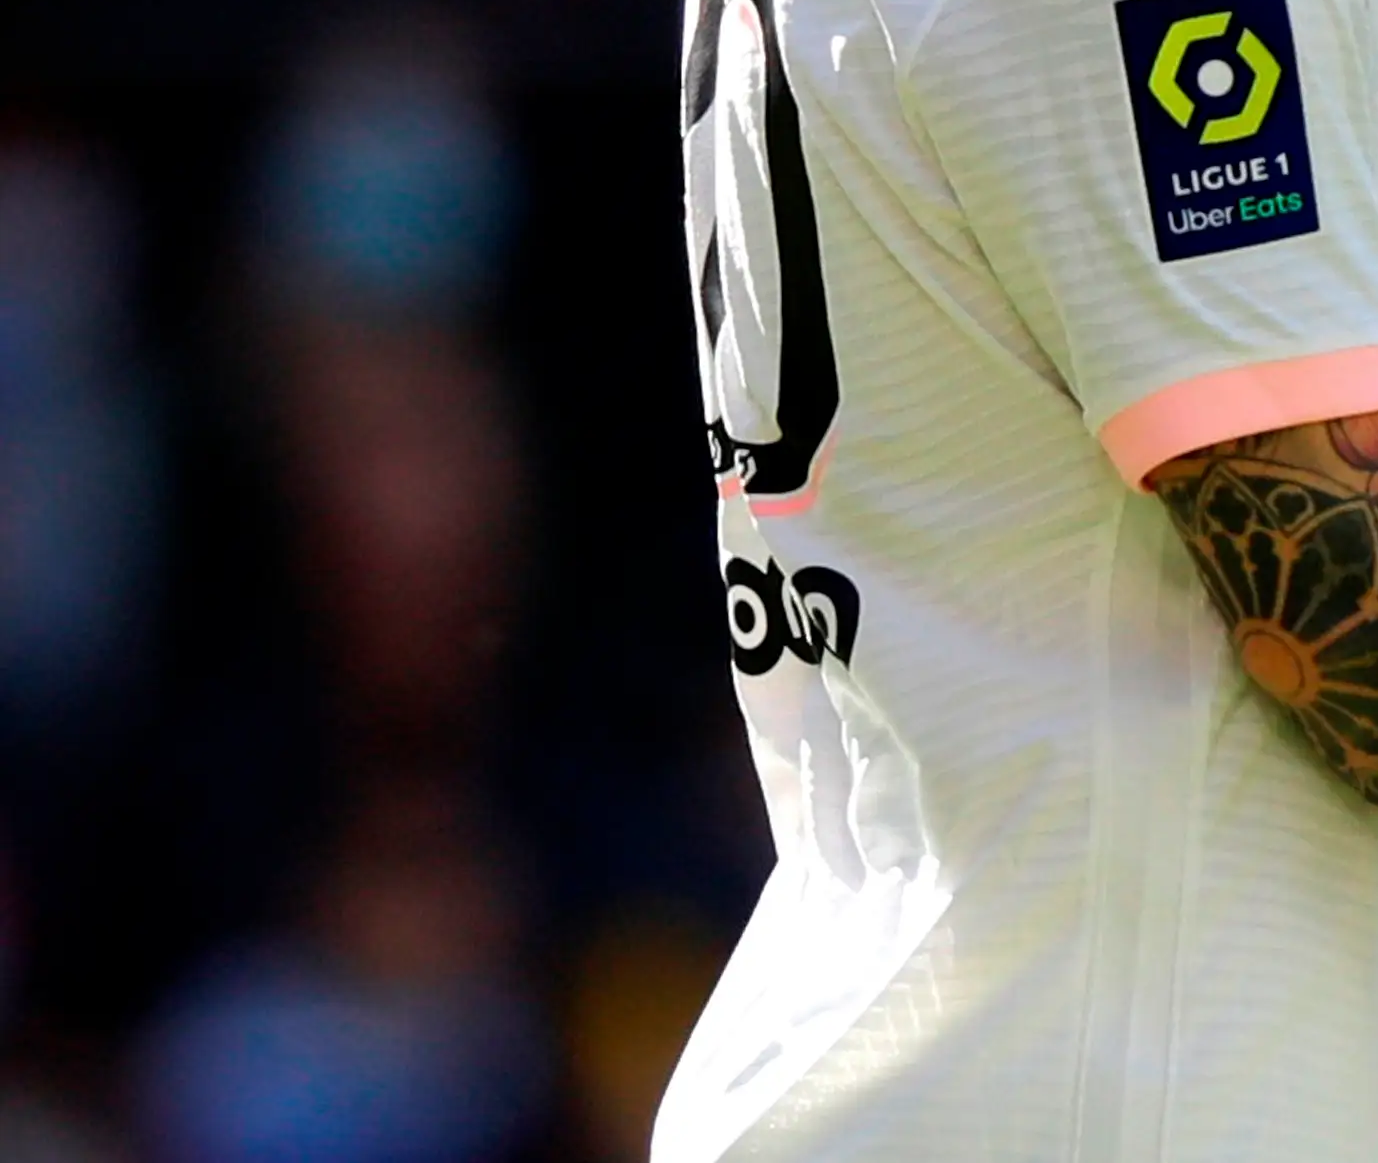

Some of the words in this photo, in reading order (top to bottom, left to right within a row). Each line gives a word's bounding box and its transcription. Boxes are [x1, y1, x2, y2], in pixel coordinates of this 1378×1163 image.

[1171, 156, 1270, 197] LIGUE
[1274, 152, 1290, 176] 1
[1167, 204, 1235, 235] Uber
[1238, 191, 1304, 222] Eats
